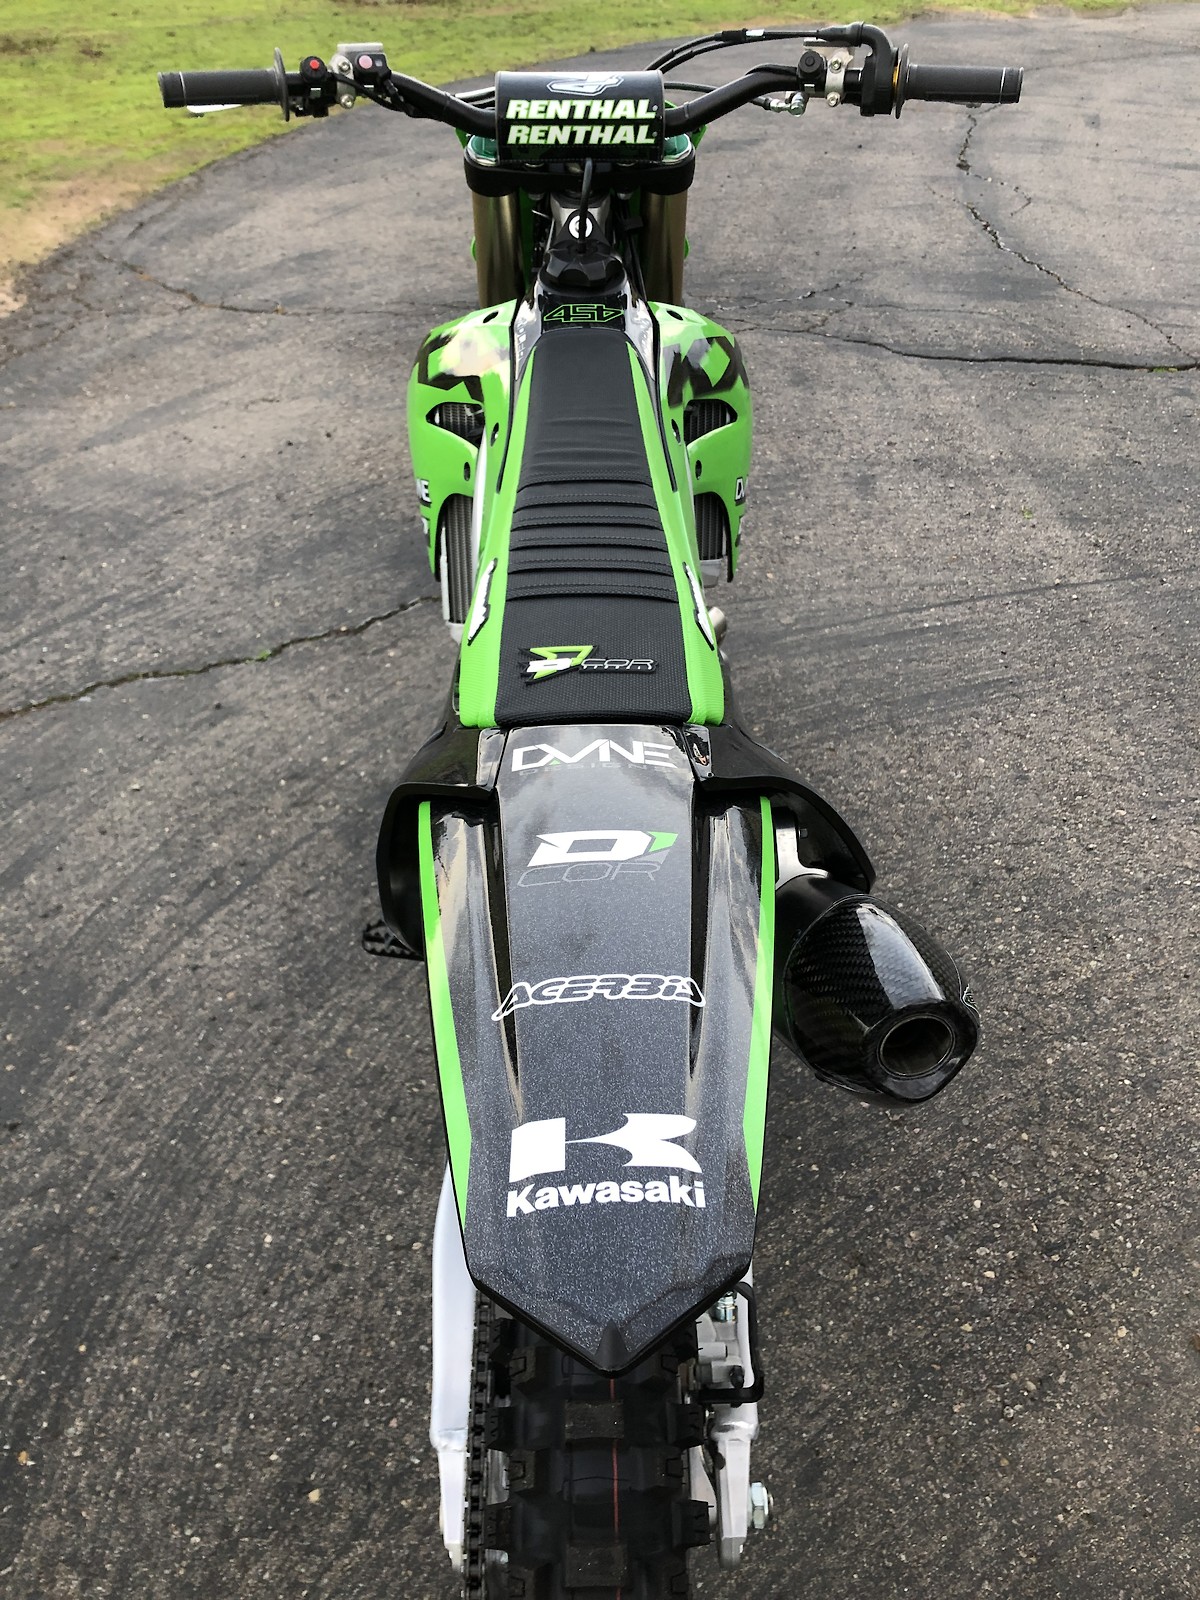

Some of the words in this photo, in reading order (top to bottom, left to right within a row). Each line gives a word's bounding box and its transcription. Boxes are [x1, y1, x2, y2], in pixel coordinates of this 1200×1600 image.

[506, 100, 656, 119] RENTHAL
[507, 125, 655, 144] RENTHAL
[518, 862, 661, 887] COR
[506, 1176, 706, 1217] Kawasaki
